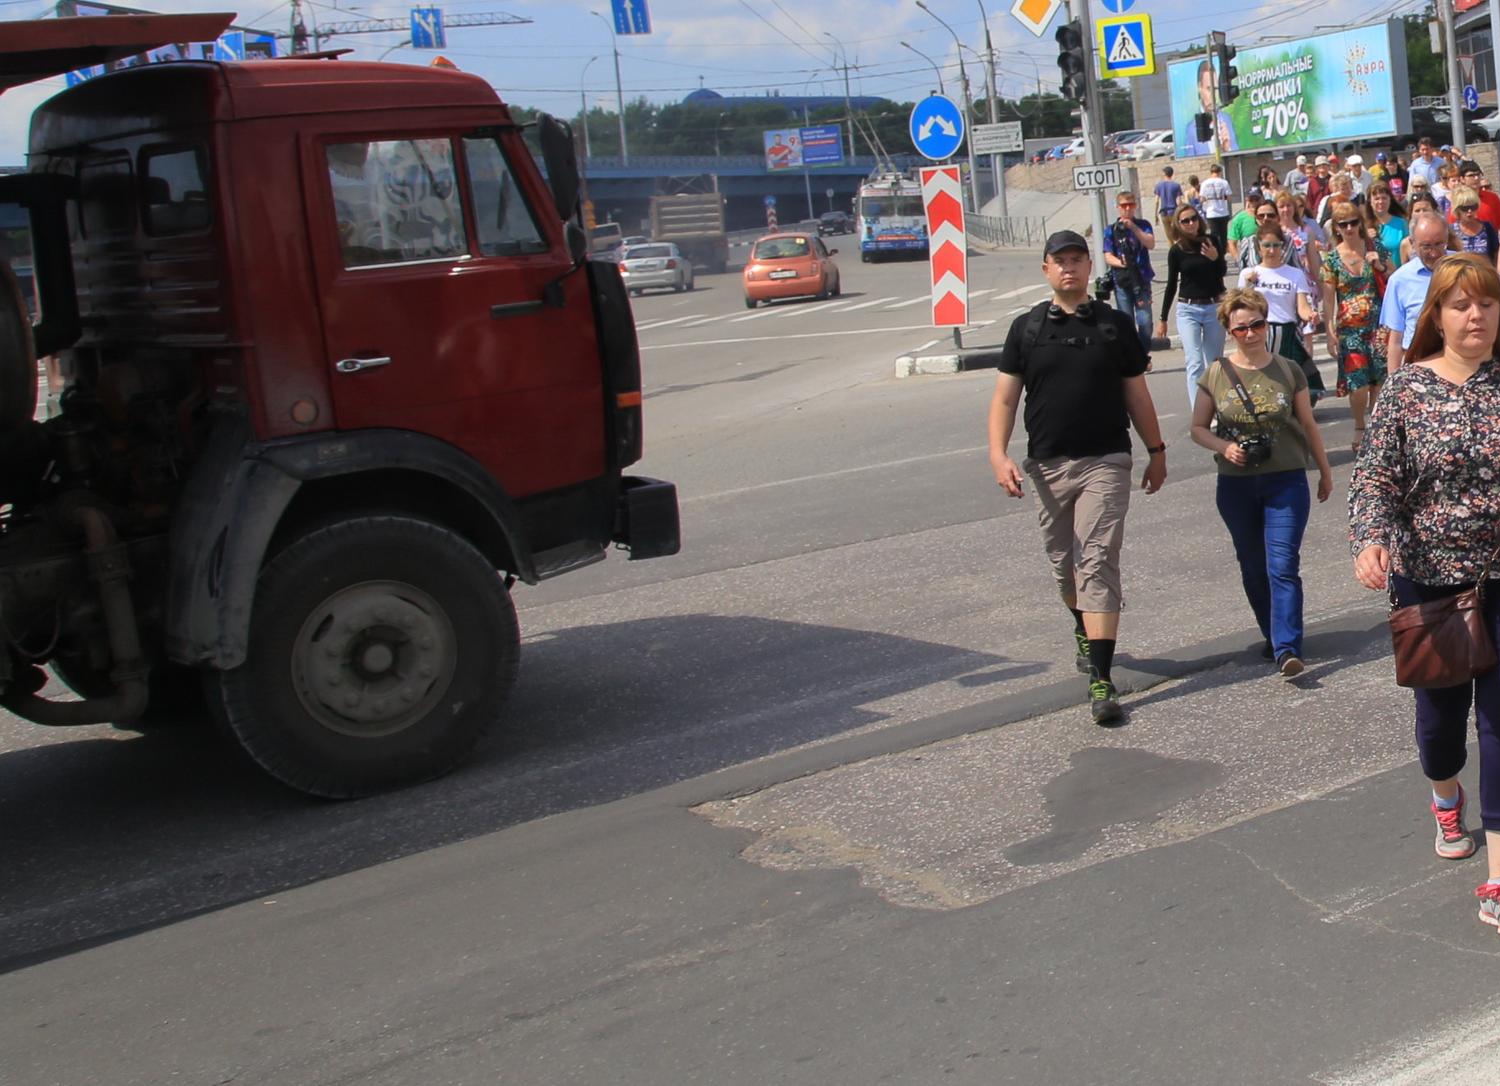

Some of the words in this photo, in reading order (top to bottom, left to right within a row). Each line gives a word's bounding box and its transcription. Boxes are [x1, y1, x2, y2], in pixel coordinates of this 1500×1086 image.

[1239, 55, 1313, 90] НОРРРМАЛЬНЫЕ
[1250, 76, 1302, 107] СКИДКИ
[1252, 97, 1309, 139] -70%
[1076, 169, 1116, 187] СТОП
[1232, 395, 1267, 406] GOD
